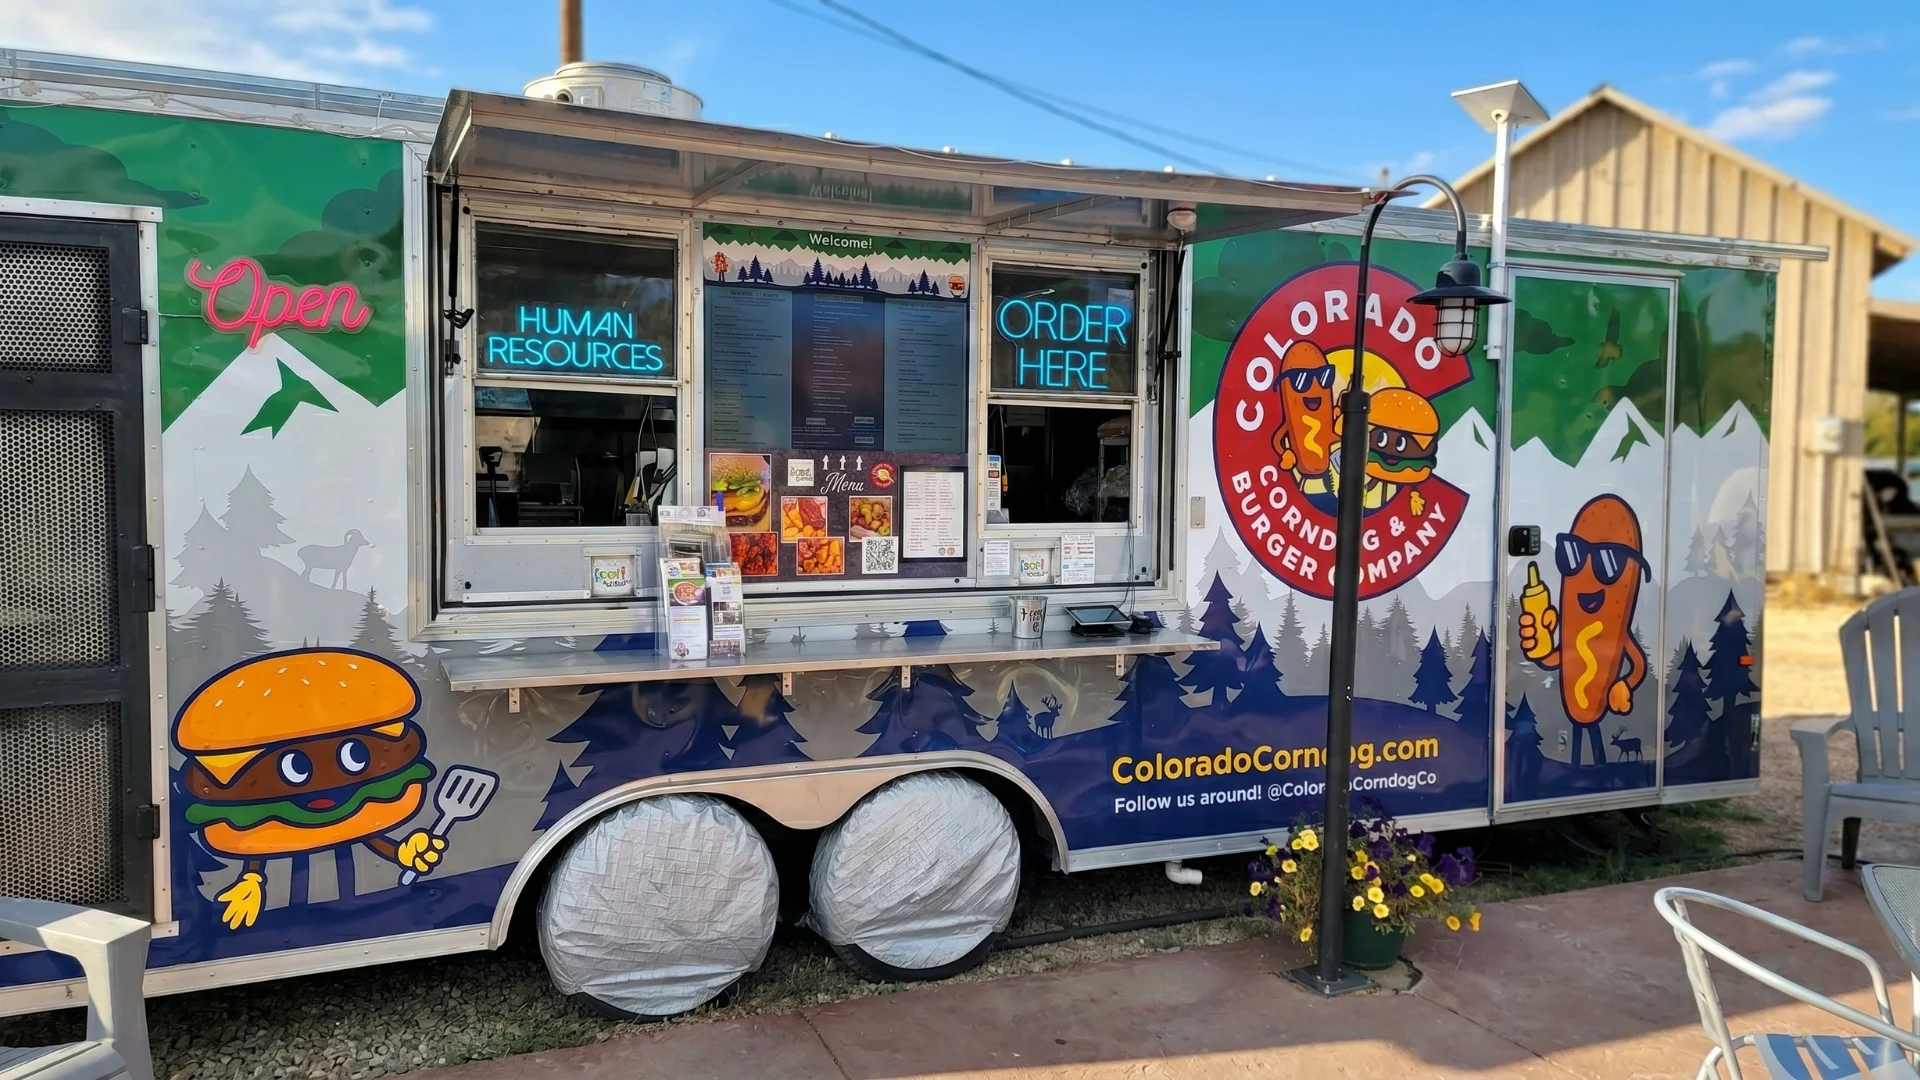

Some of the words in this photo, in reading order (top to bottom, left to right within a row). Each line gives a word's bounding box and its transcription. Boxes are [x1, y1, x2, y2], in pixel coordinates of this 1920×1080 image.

[809, 232, 872, 249] Welcome!
[188, 258, 369, 349] Open
[520, 305, 633, 340] HUMAN
[1000, 299, 1127, 345] ORDER
[488, 336, 664, 371] RESOURCES
[1019, 348, 1108, 389] HERE
[1236, 289, 1442, 432] COLORADO
[820, 471, 864, 495] Menu
[1231, 470, 1319, 581] BURGER
[1327, 502, 1447, 588] MPANY
[1259, 464, 1380, 551] CORNDG
[1389, 515, 1407, 538] &
[1112, 736, 1439, 785] ColoradoCorng.com
[1114, 794, 1172, 814] Follow
[1177, 793, 1196, 808] us
[1200, 784, 1262, 806] around!
[1267, 770, 1437, 802] @ColorCorndogCo
